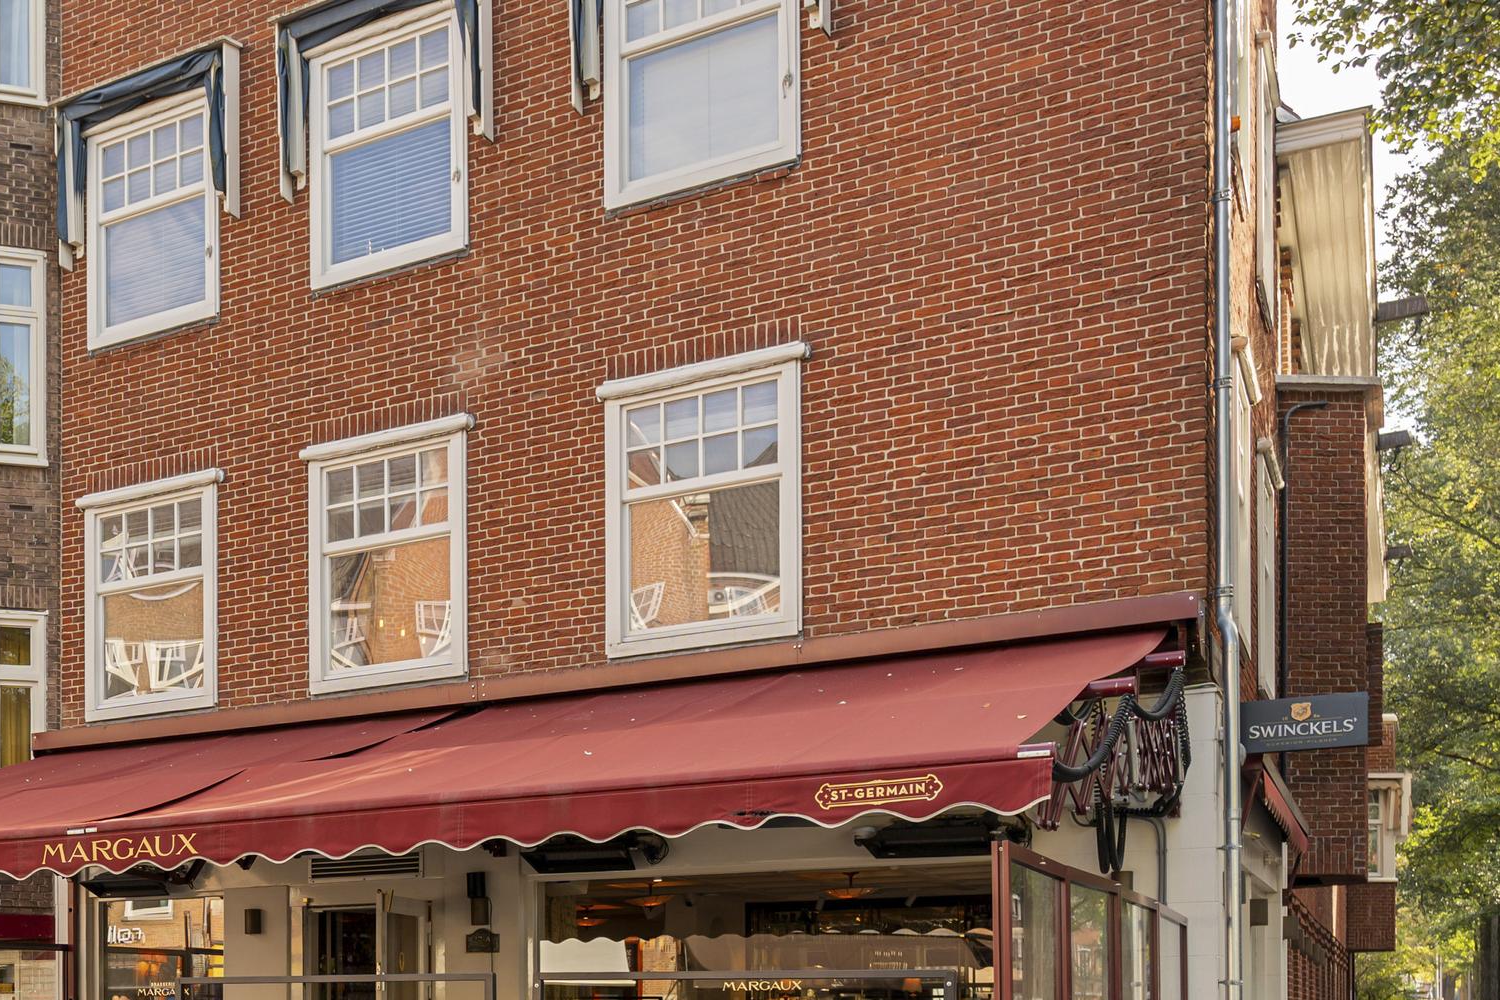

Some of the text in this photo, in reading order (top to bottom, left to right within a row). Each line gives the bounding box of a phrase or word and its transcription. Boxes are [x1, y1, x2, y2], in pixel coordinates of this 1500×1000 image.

[1248, 716, 1358, 740] SWINCKELS'
[830, 782, 926, 801] ST-GERMAIN
[41, 832, 199, 865] MARGAUX
[137, 987, 190, 997] MARGAX
[722, 980, 802, 992] MARGAUX
